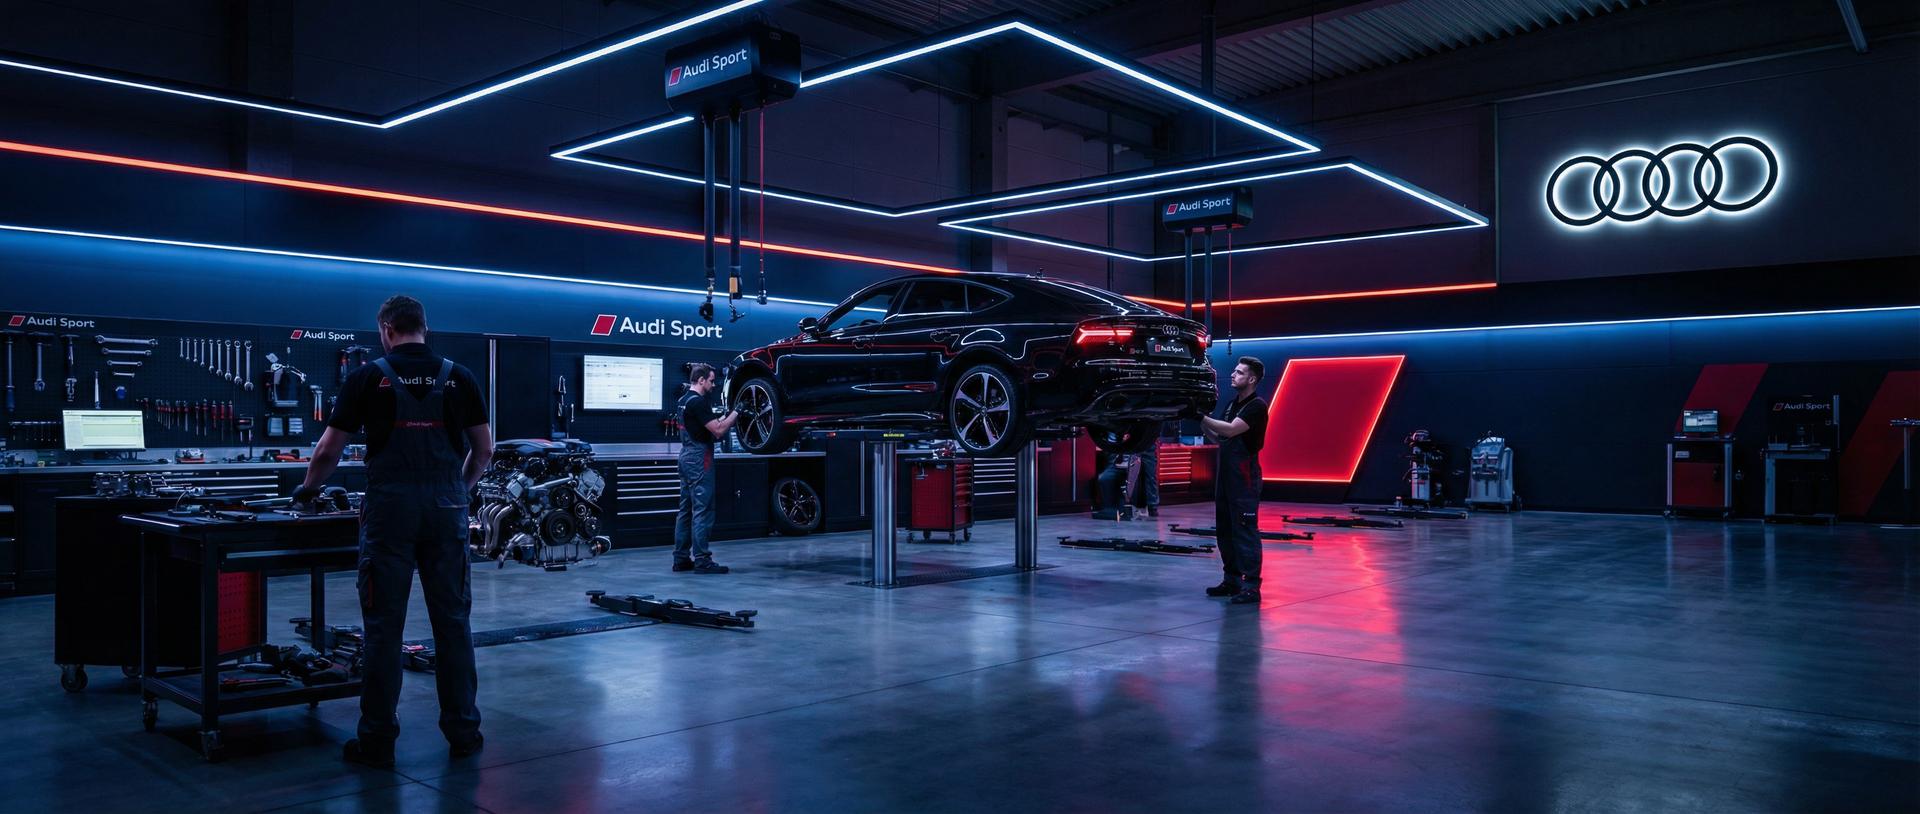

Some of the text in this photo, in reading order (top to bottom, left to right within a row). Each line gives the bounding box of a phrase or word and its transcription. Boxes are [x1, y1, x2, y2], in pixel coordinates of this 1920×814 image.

[683, 48, 748, 79] Audi Sport
[1179, 198, 1231, 212] Audi Sport
[27, 316, 95, 329] Audi Sport
[620, 316, 723, 341] Audi Sport
[303, 330, 355, 341] Audi Sport
[425, 376, 456, 388] Srt
[1784, 402, 1830, 411] Audi Sport
